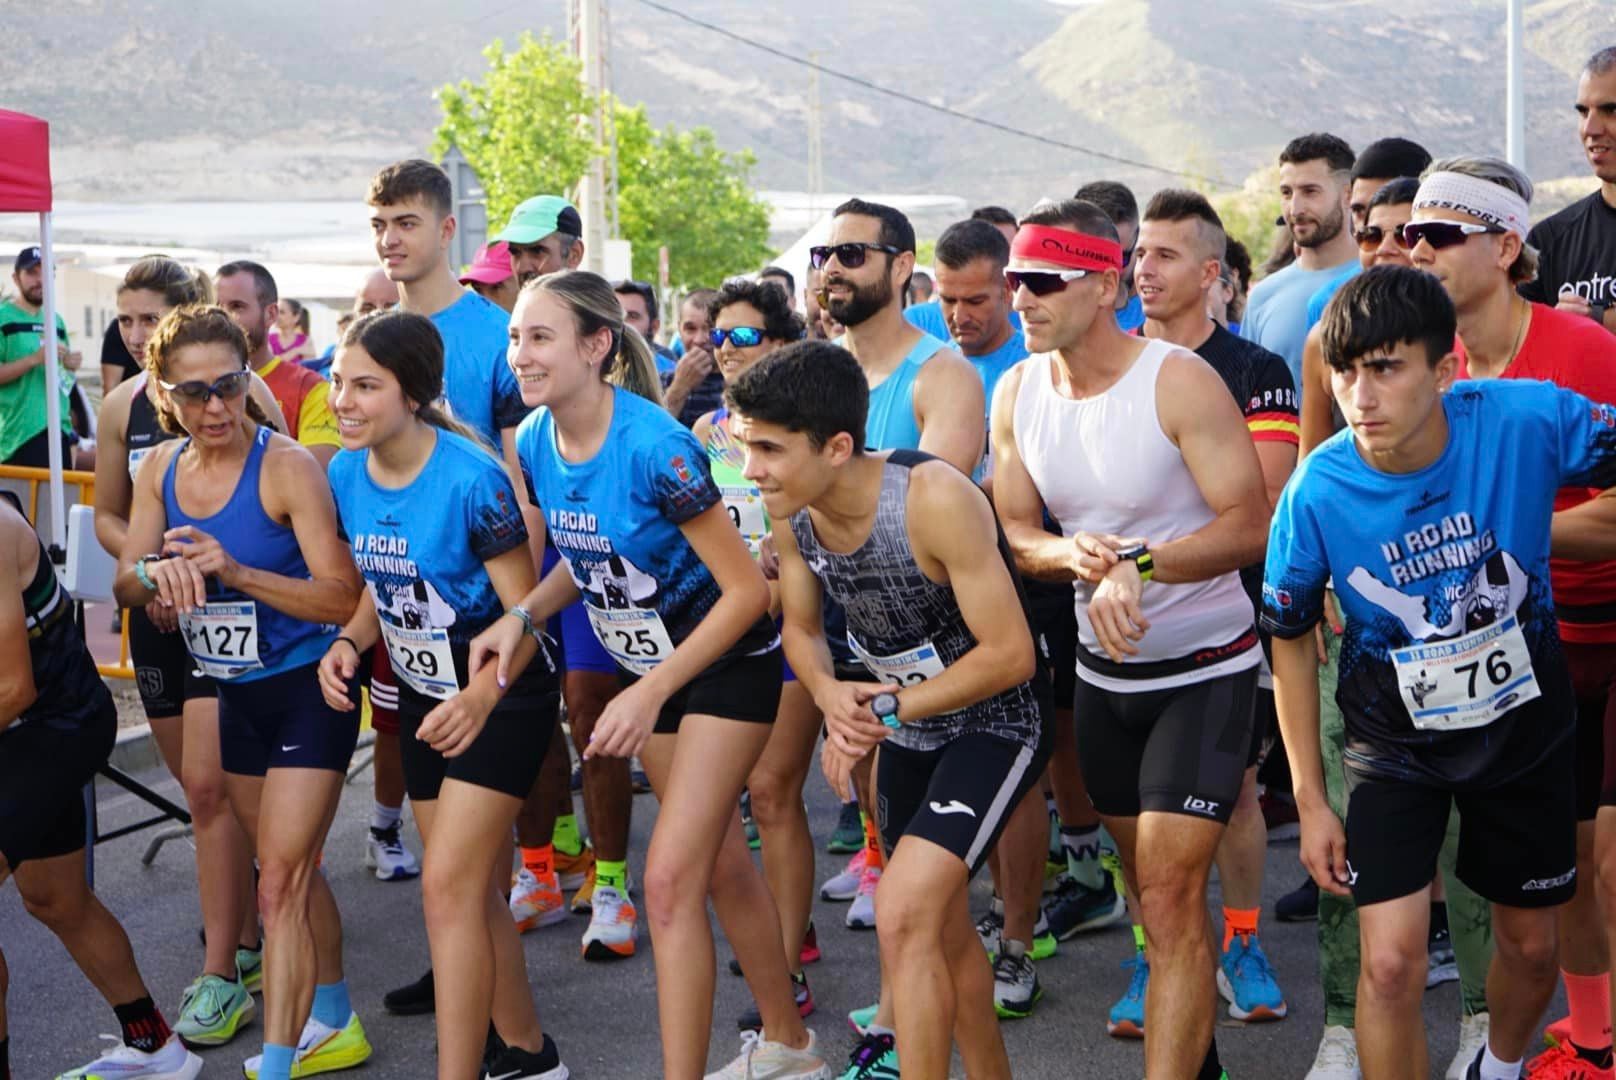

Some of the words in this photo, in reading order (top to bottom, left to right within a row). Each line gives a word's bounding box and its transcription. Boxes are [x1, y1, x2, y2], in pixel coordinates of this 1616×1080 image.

[559, 510, 598, 533] ROAD
[1381, 541, 1402, 563] II
[1404, 511, 1474, 553] ROAD
[354, 534, 365, 553] II
[367, 534, 408, 557] ROAD
[551, 529, 613, 554] RUNNING
[1390, 529, 1495, 585] RUNNING
[355, 553, 418, 577] RUNNING
[199, 624, 252, 656] 127
[615, 629, 660, 657] 25
[1422, 643, 1454, 661] ROAD
[1455, 625, 1503, 655] RUNNING
[399, 646, 439, 678] 29
[1453, 649, 1512, 699] 76
